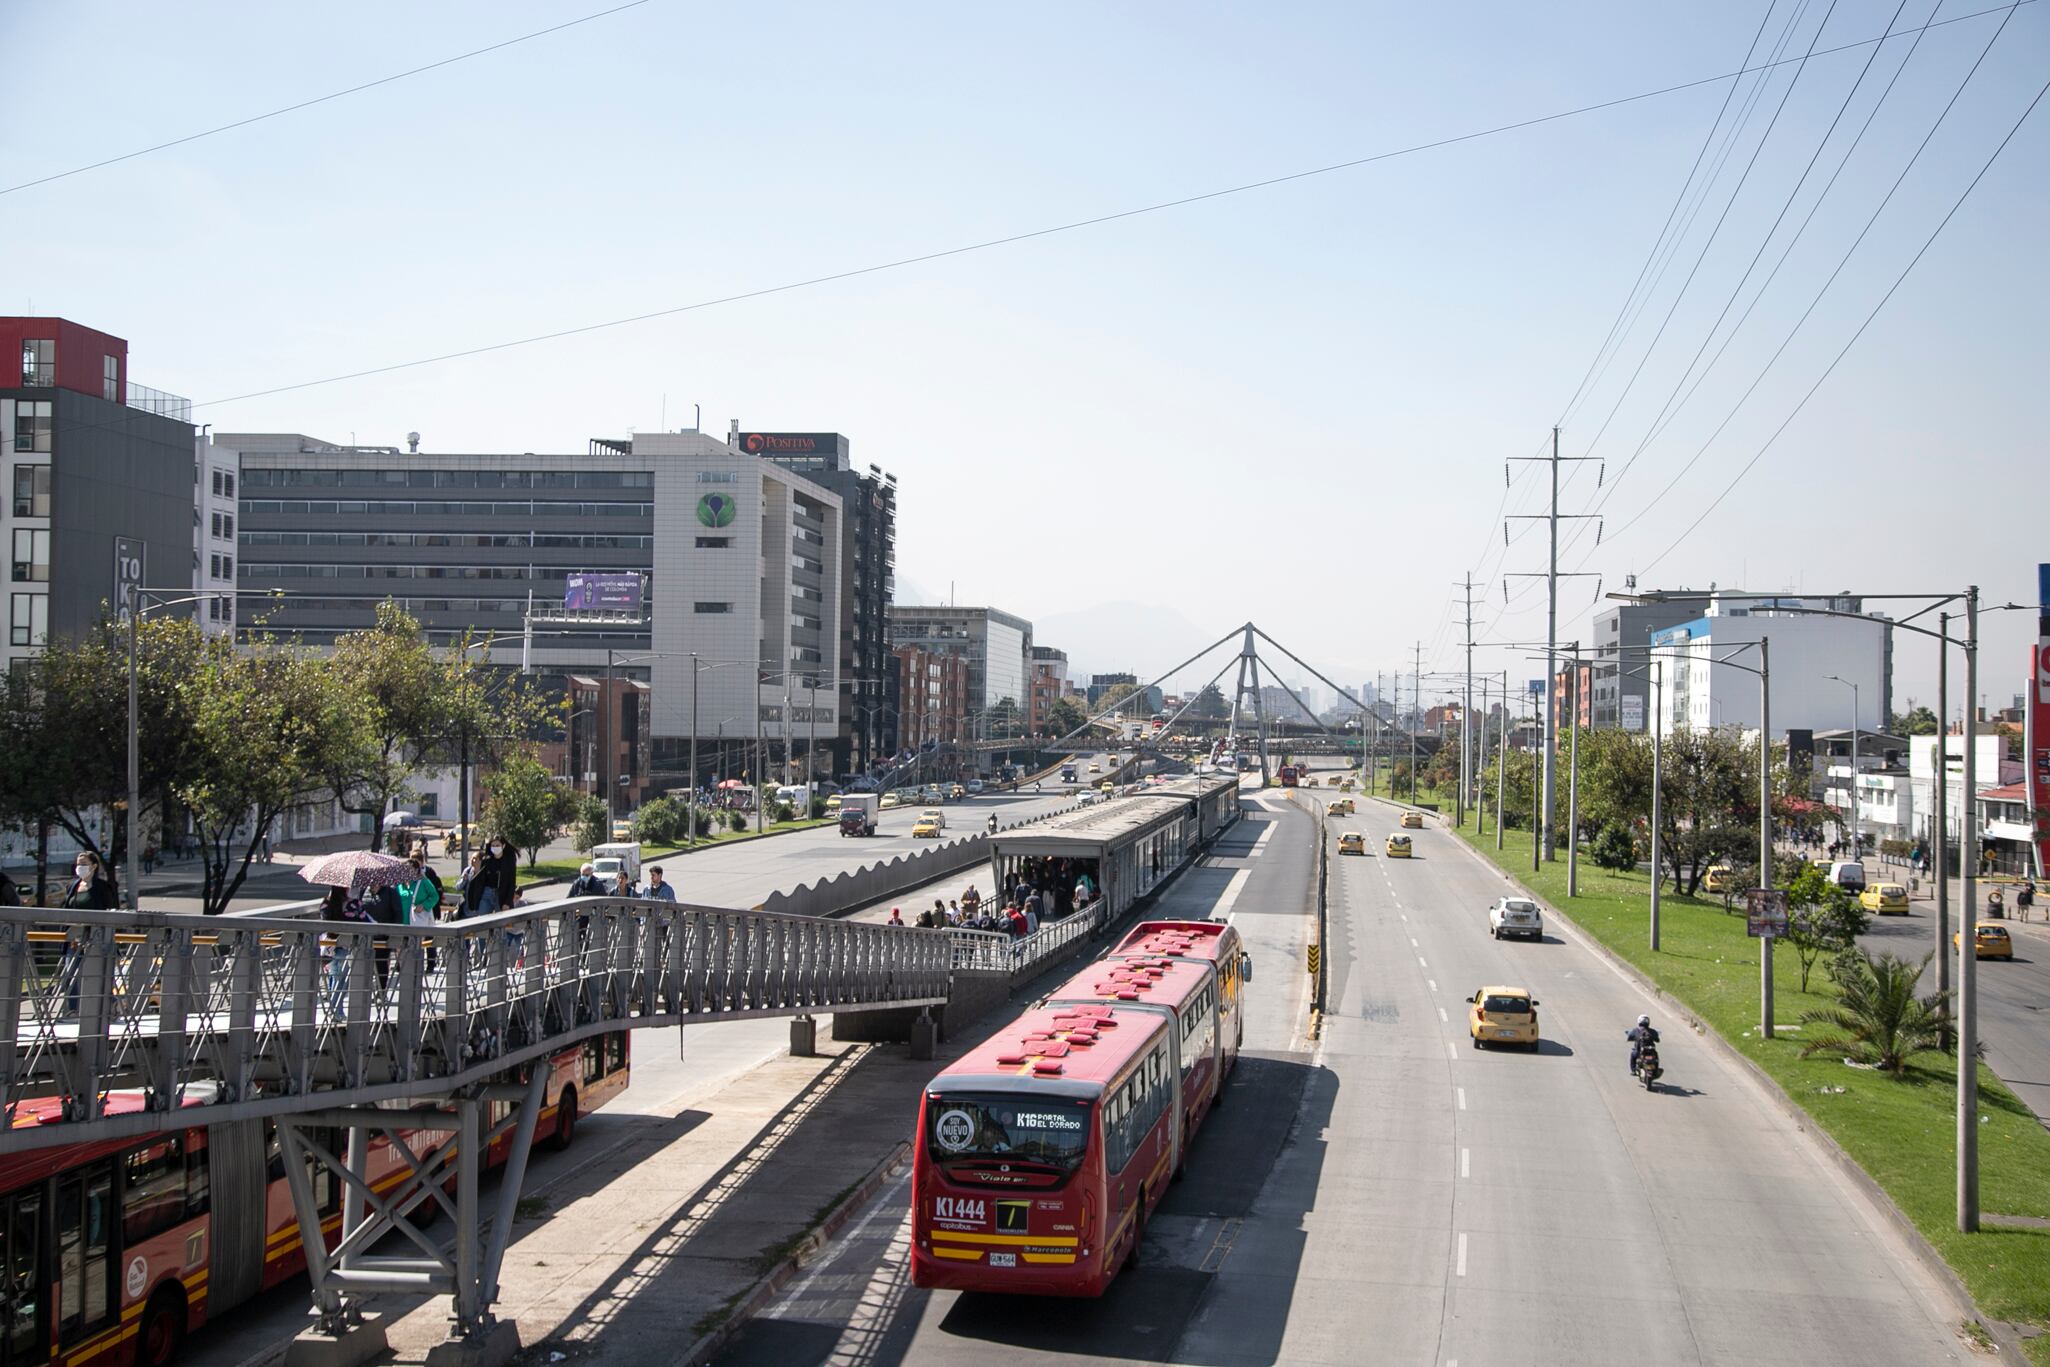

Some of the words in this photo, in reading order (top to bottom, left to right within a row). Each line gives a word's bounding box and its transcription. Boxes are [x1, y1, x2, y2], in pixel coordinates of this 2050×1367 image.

[766, 436, 816, 448] POSITIVA
[120, 557, 140, 579] TO
[950, 1117, 960, 1125] SOY
[1016, 1113, 1037, 1127] K16
[1037, 1114, 1066, 1122] PORTAL
[943, 1125, 968, 1136] NUEVO
[1049, 1121, 1081, 1129] DORADO
